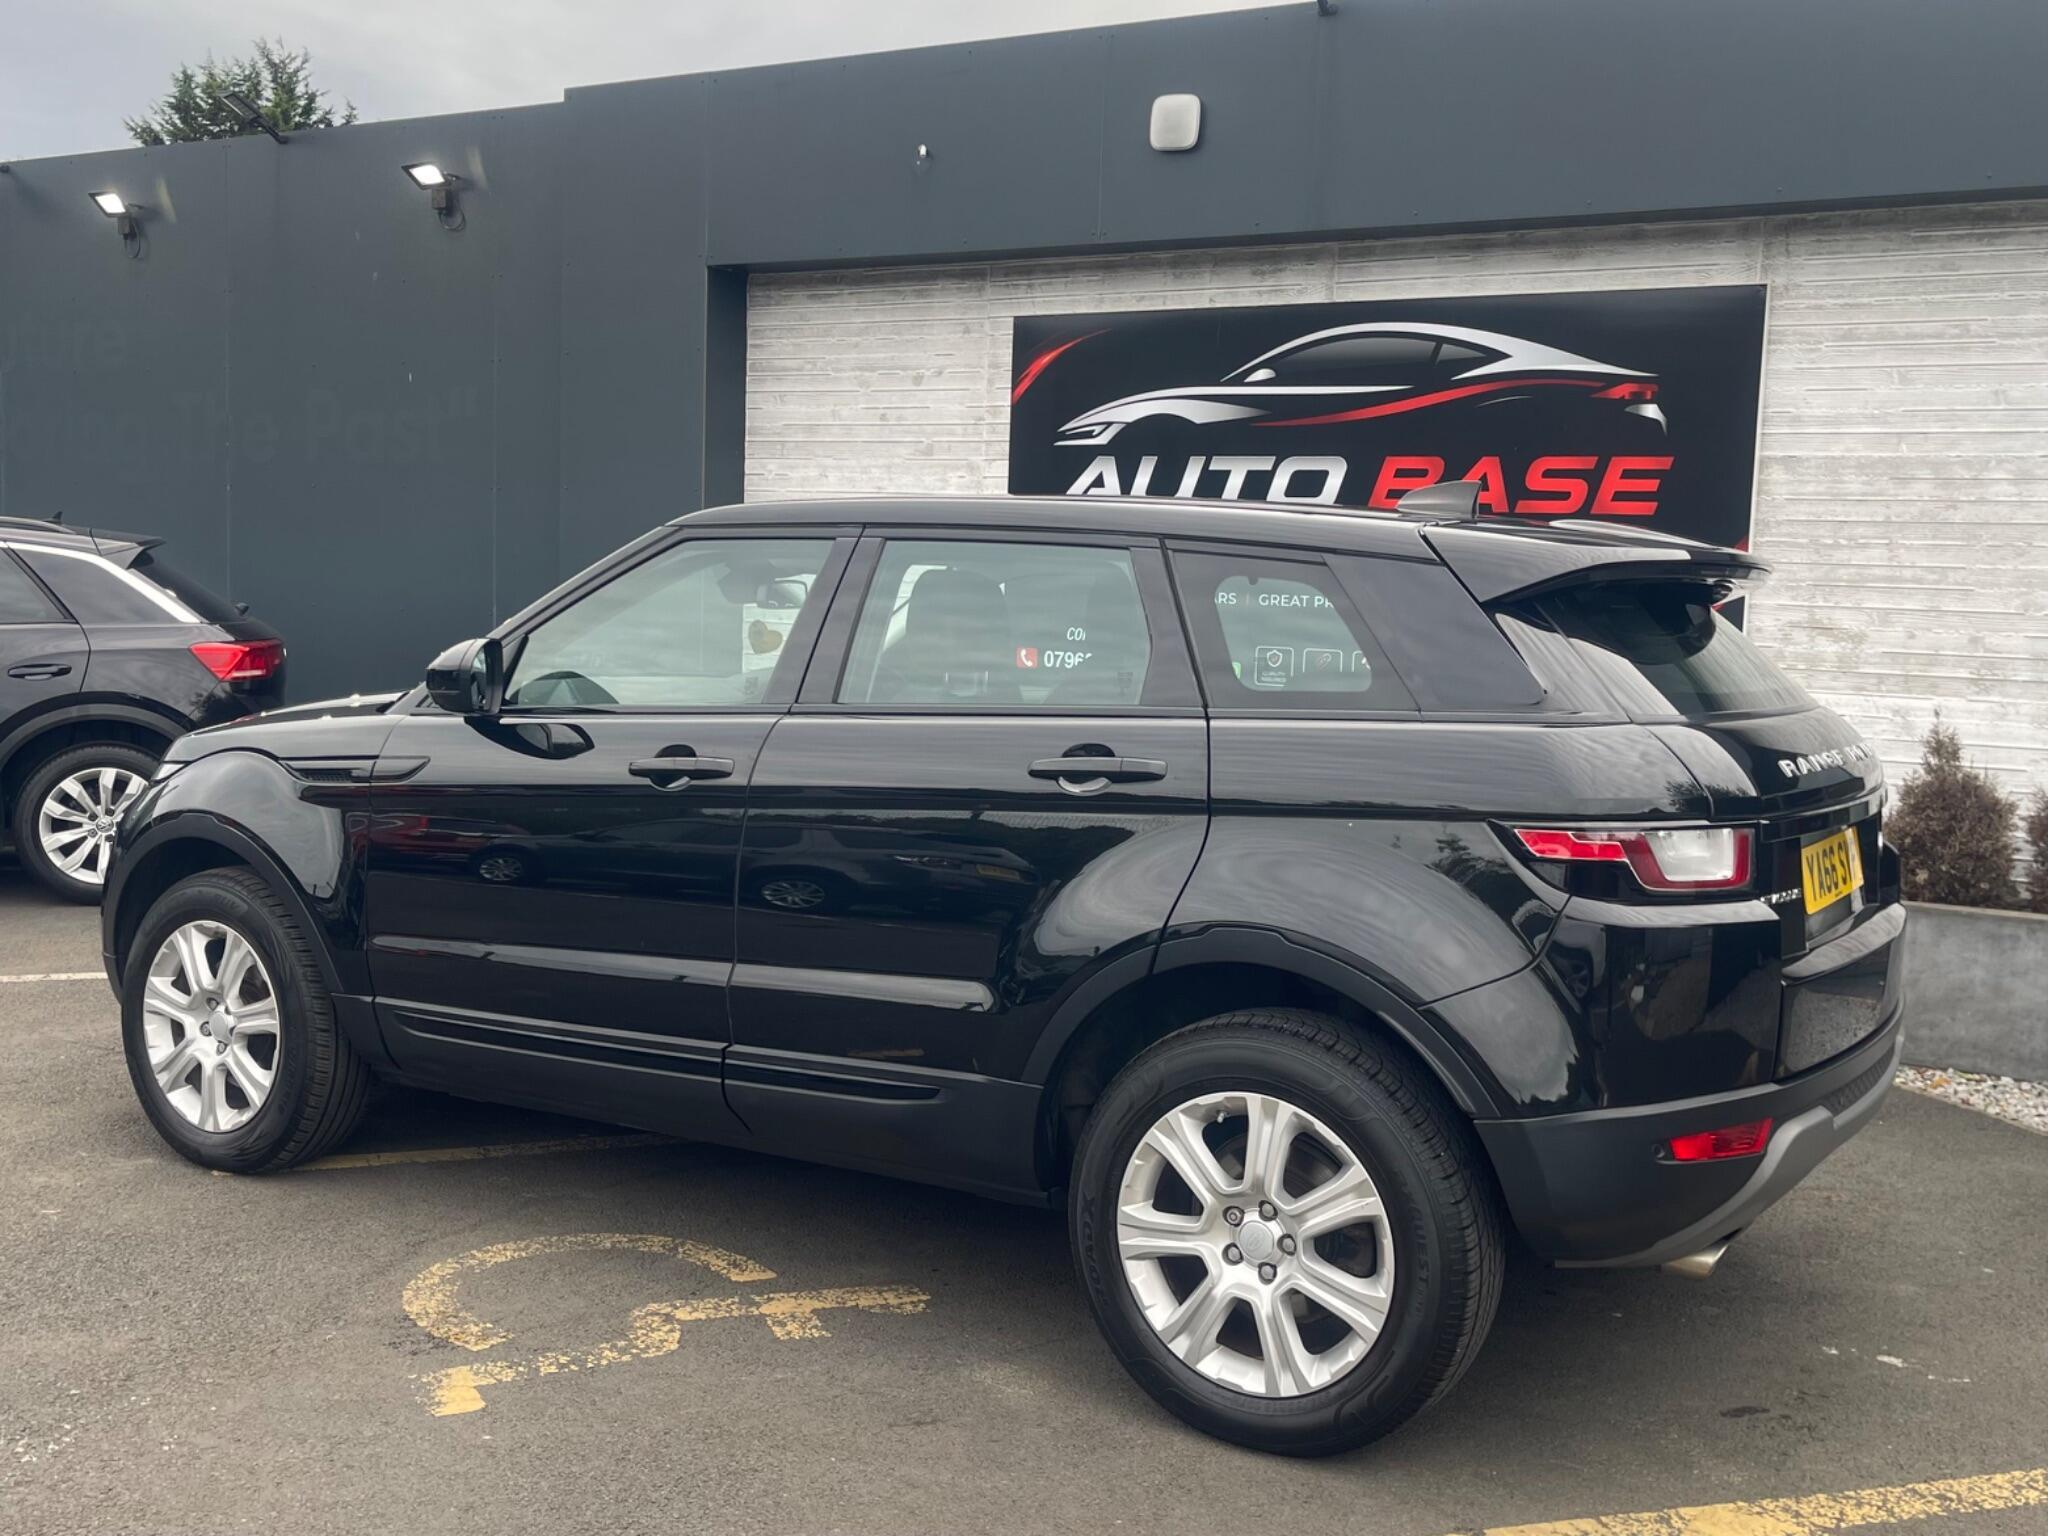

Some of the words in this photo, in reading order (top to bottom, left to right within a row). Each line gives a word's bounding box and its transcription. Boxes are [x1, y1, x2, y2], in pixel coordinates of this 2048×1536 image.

[1065, 455, 1347, 505] AUTO
[1368, 455, 1675, 515] BASE
[1214, 592, 1237, 605] RS
[1258, 593, 1311, 608] GREAT
[1043, 650, 1093, 669] 0796
[1777, 749, 1844, 778] RANGE
[1805, 845, 1839, 903] YA66
